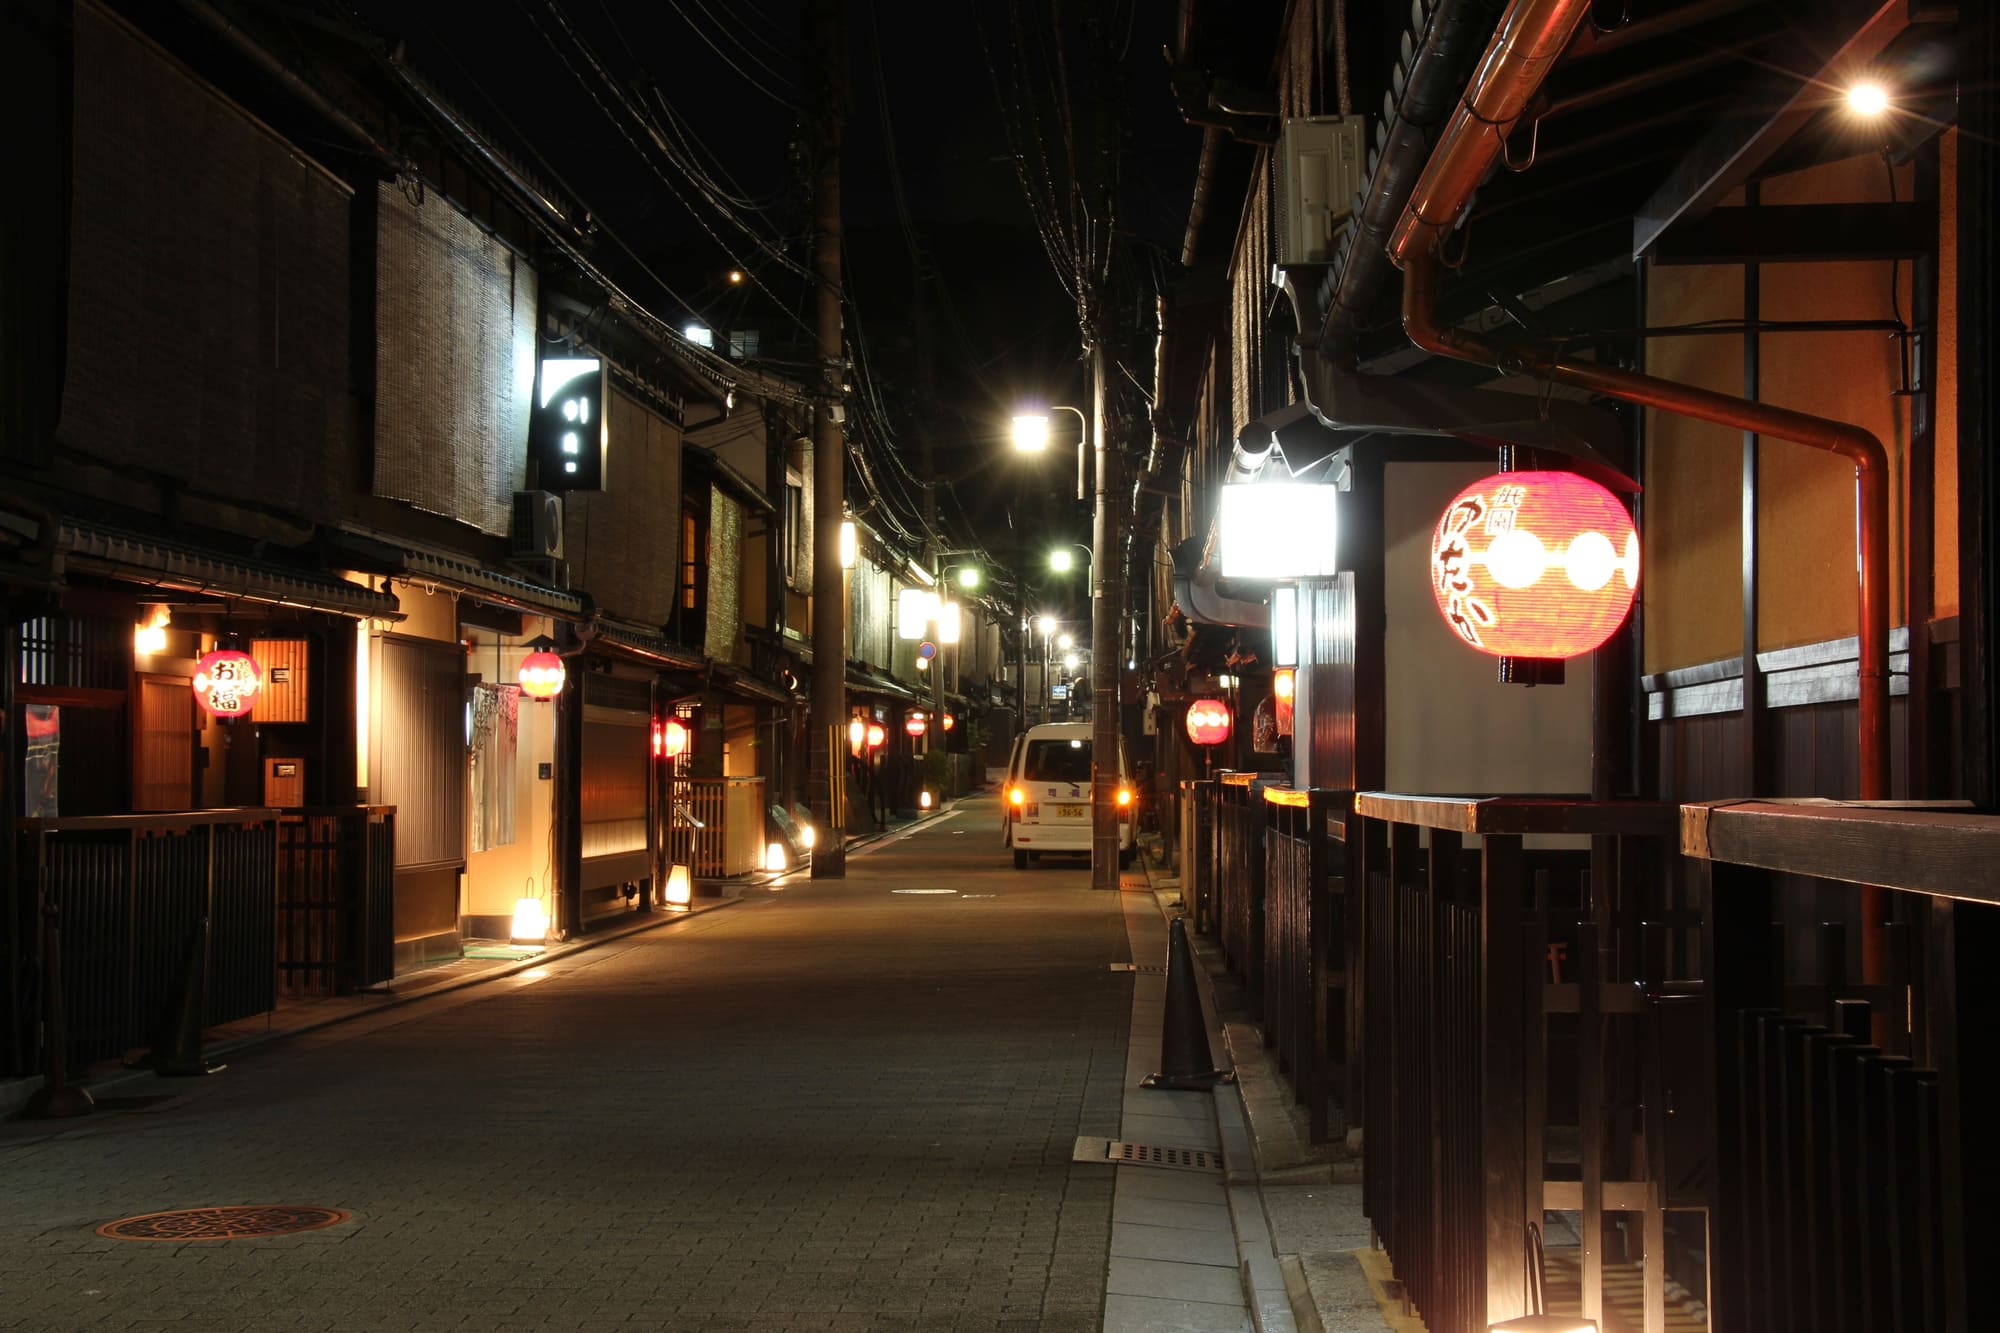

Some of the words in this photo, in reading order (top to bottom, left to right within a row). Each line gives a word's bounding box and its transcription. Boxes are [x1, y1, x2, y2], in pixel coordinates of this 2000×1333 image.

[1438, 498, 1489, 644] ゆたか
[211, 661, 238, 710] お福
